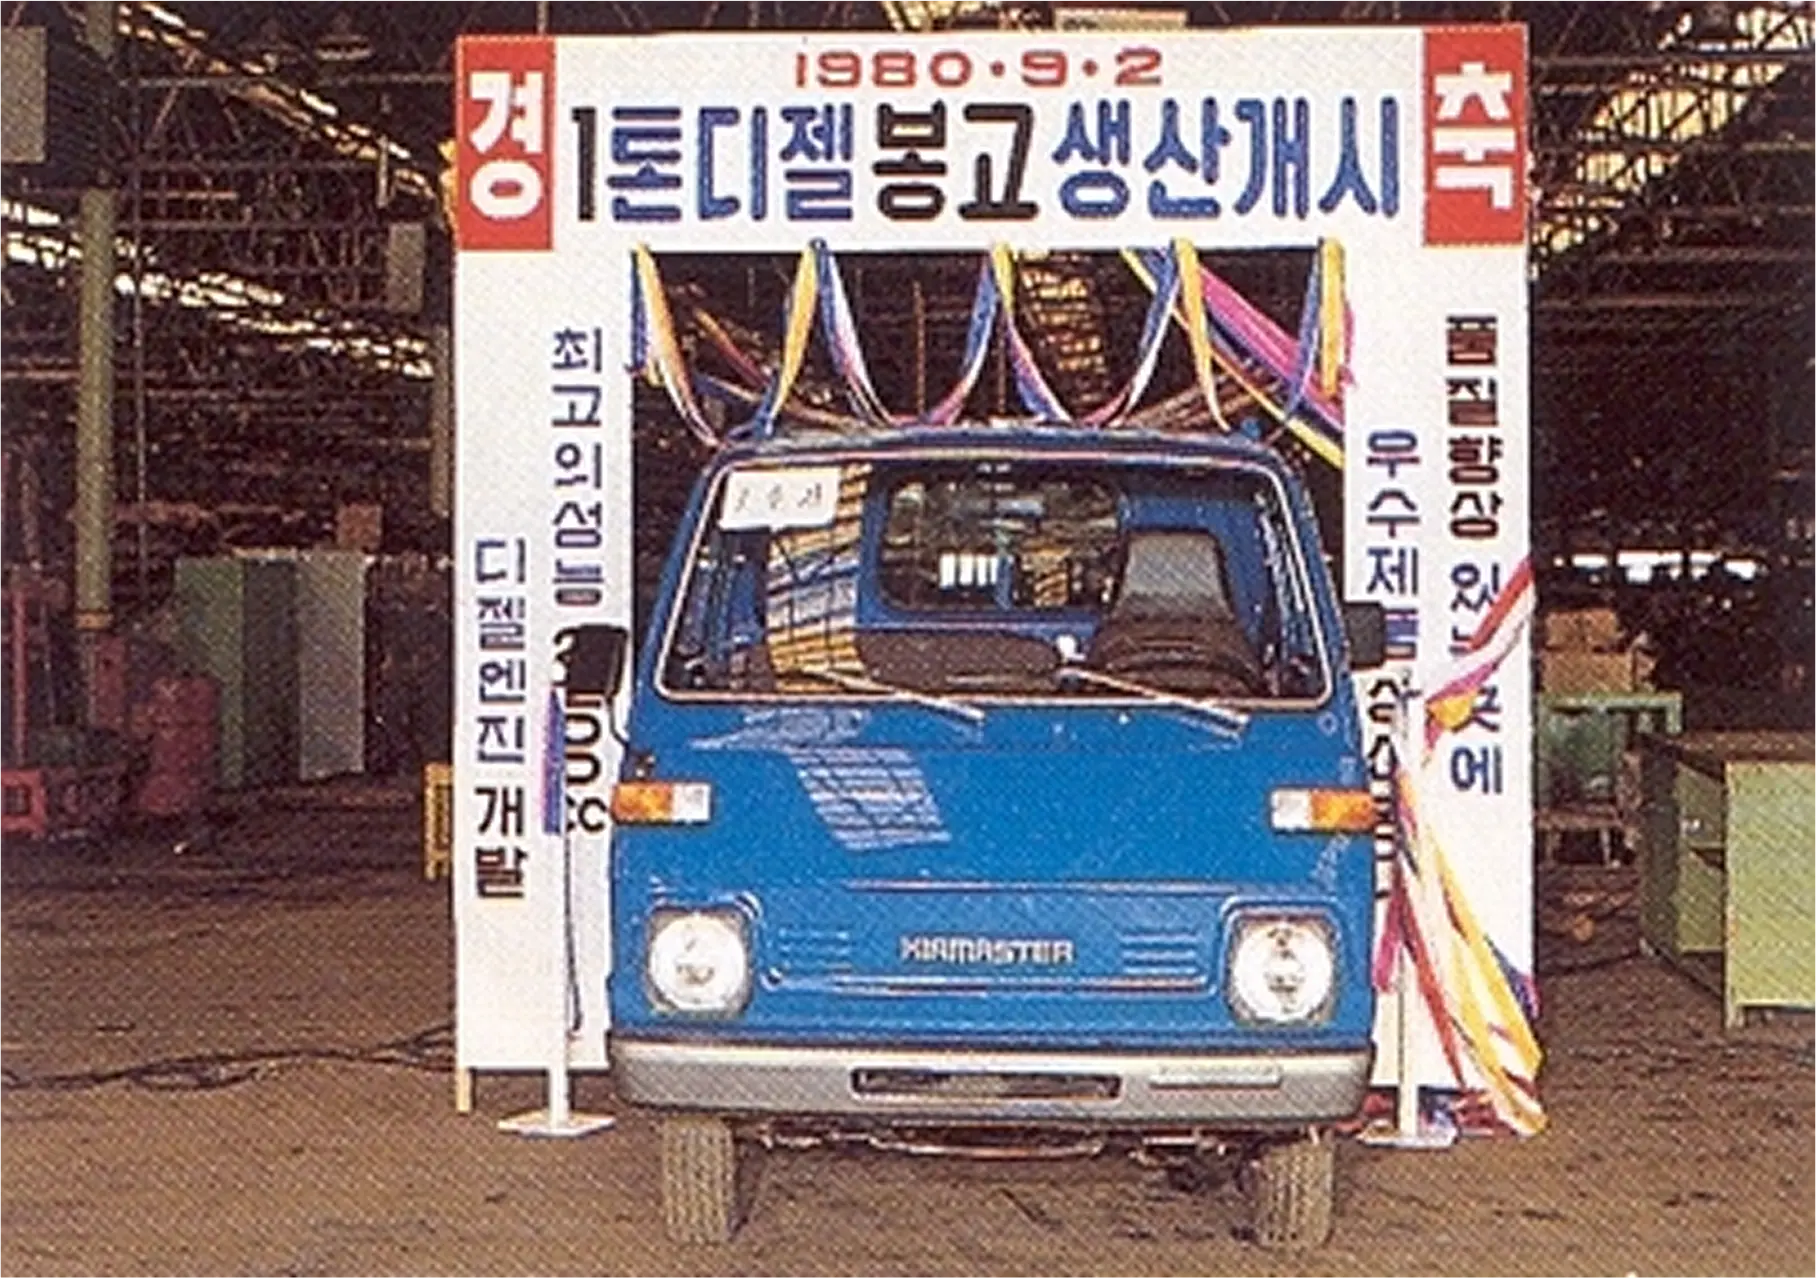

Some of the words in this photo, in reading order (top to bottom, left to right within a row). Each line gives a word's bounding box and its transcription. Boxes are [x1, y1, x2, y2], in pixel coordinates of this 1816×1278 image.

[470, 71, 543, 219] 경
[1432, 62, 1515, 209] 축
[474, 786, 528, 899] 개발
